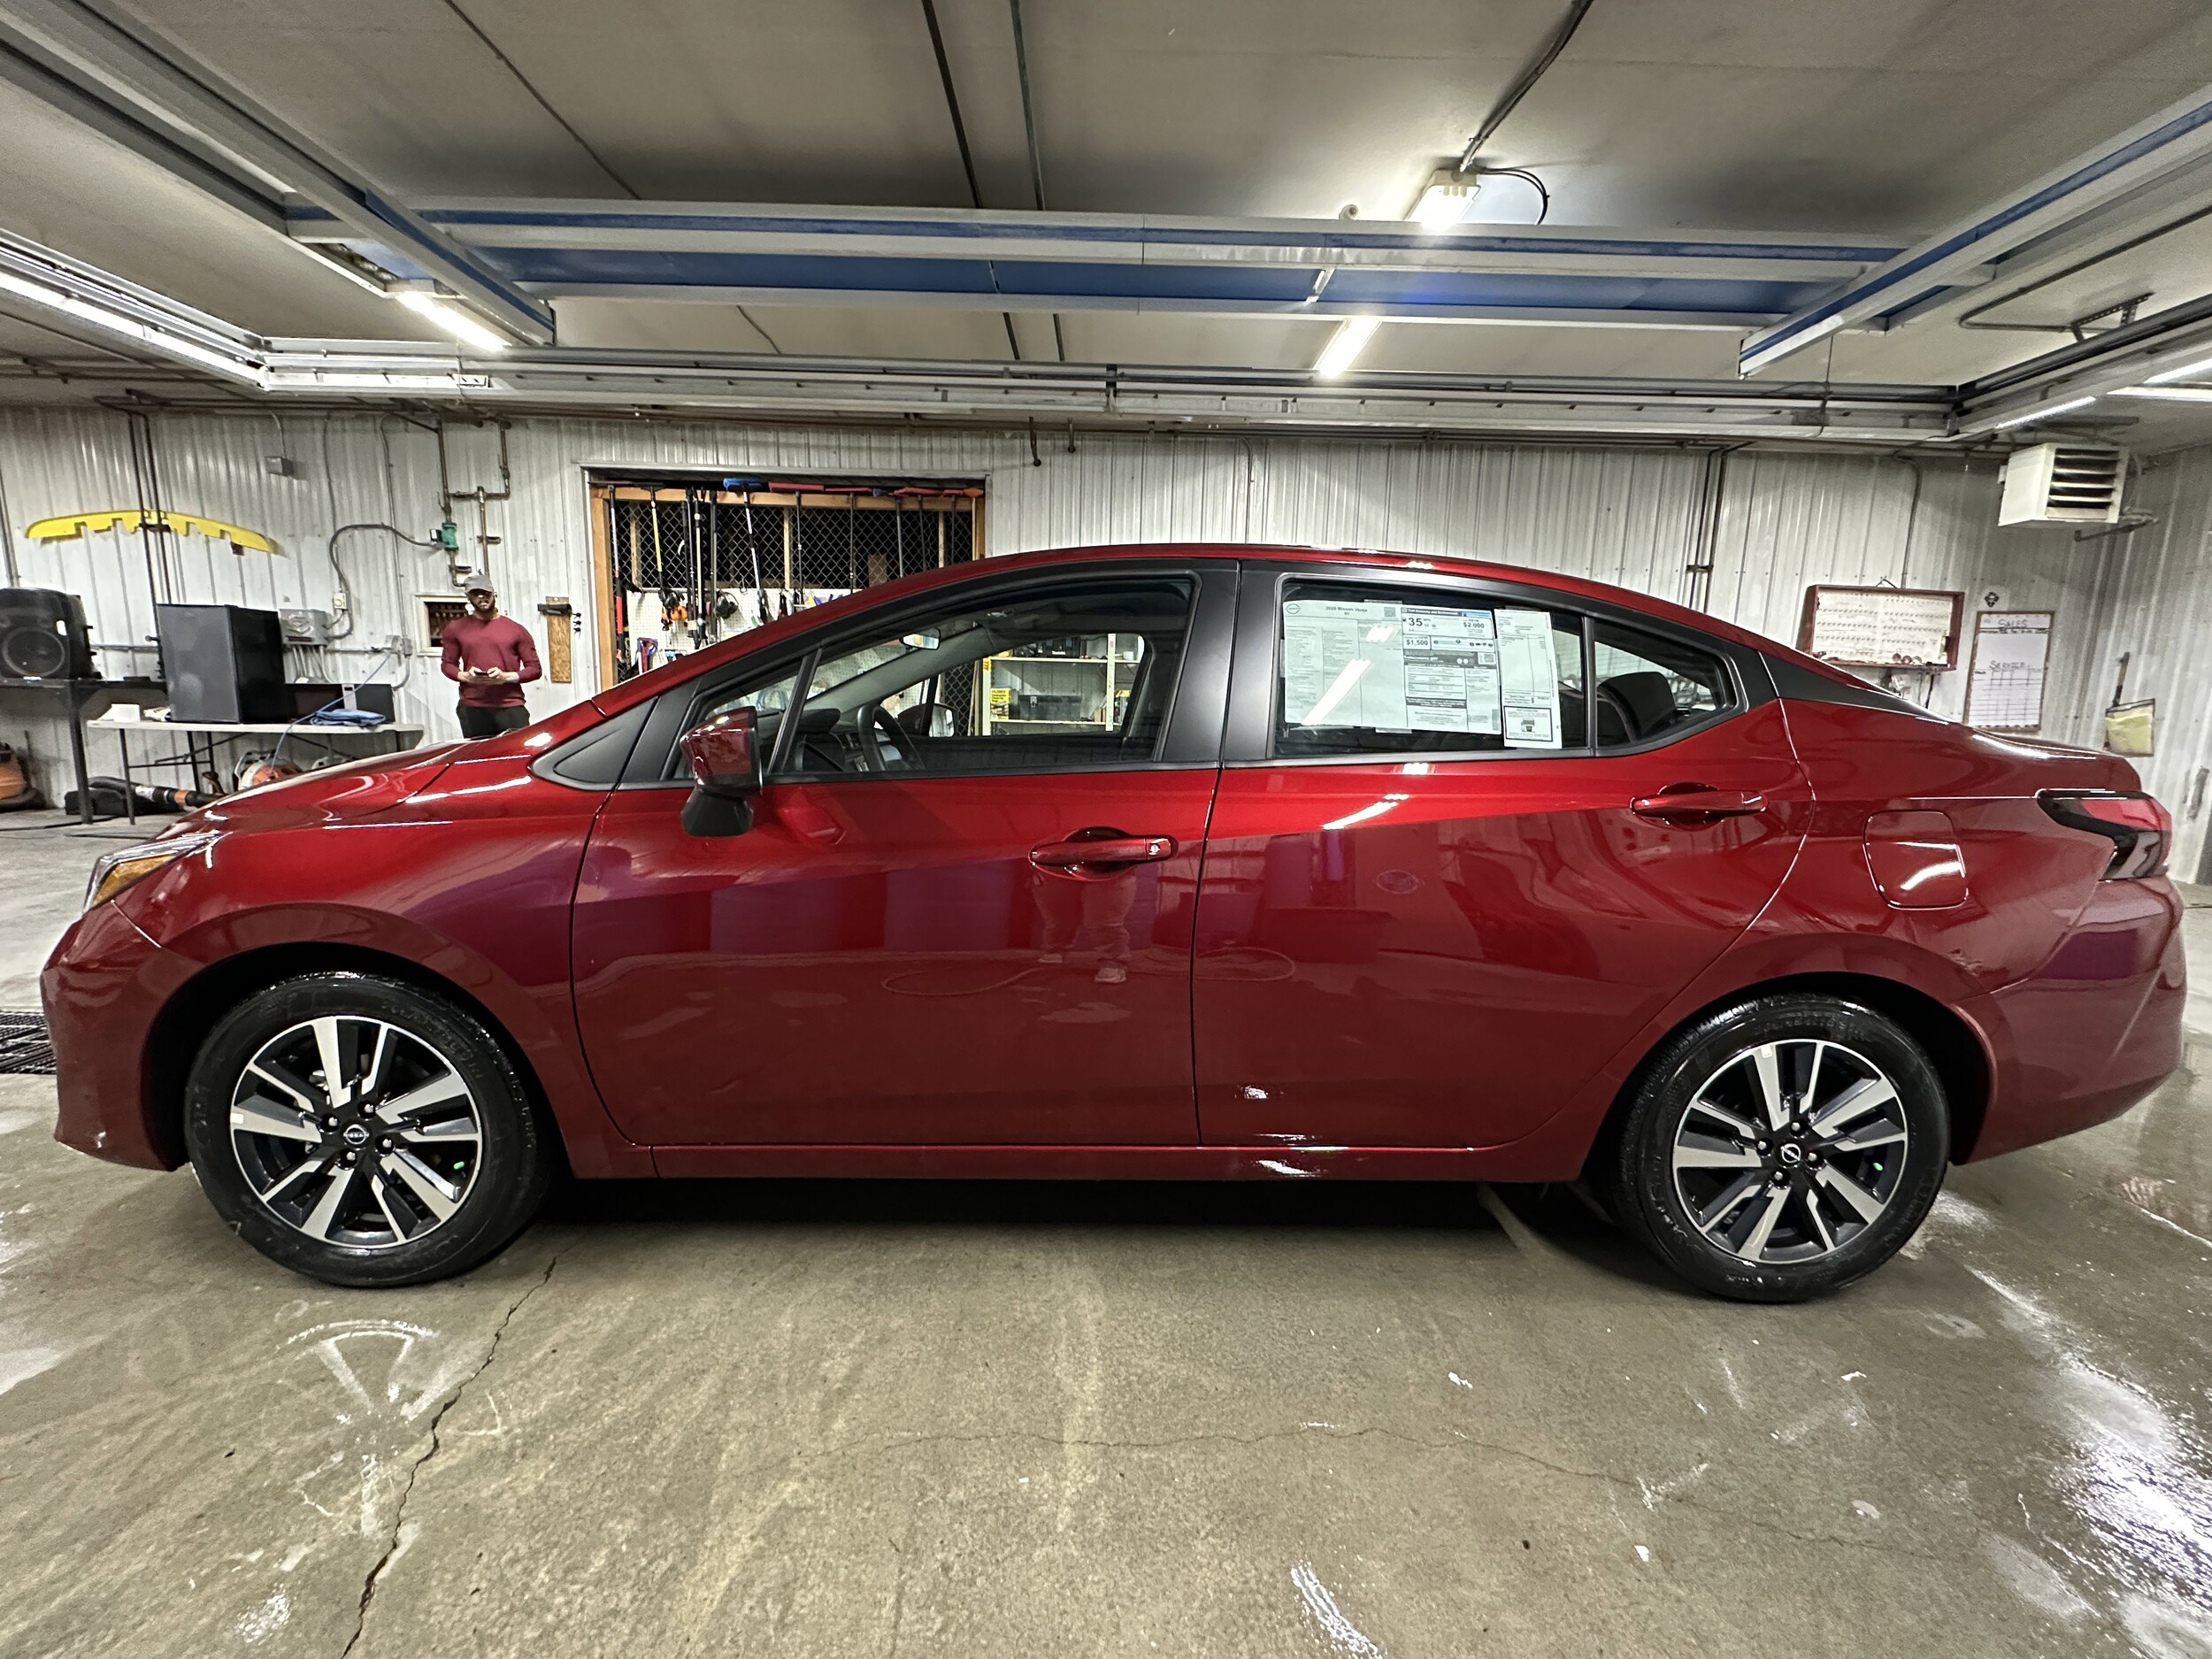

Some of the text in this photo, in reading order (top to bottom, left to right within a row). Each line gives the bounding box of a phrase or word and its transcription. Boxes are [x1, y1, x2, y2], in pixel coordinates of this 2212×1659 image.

[1408, 617, 1423, 626] 35
[1998, 618, 2028, 628] SALES
[1989, 660, 2025, 672] SERVICE
